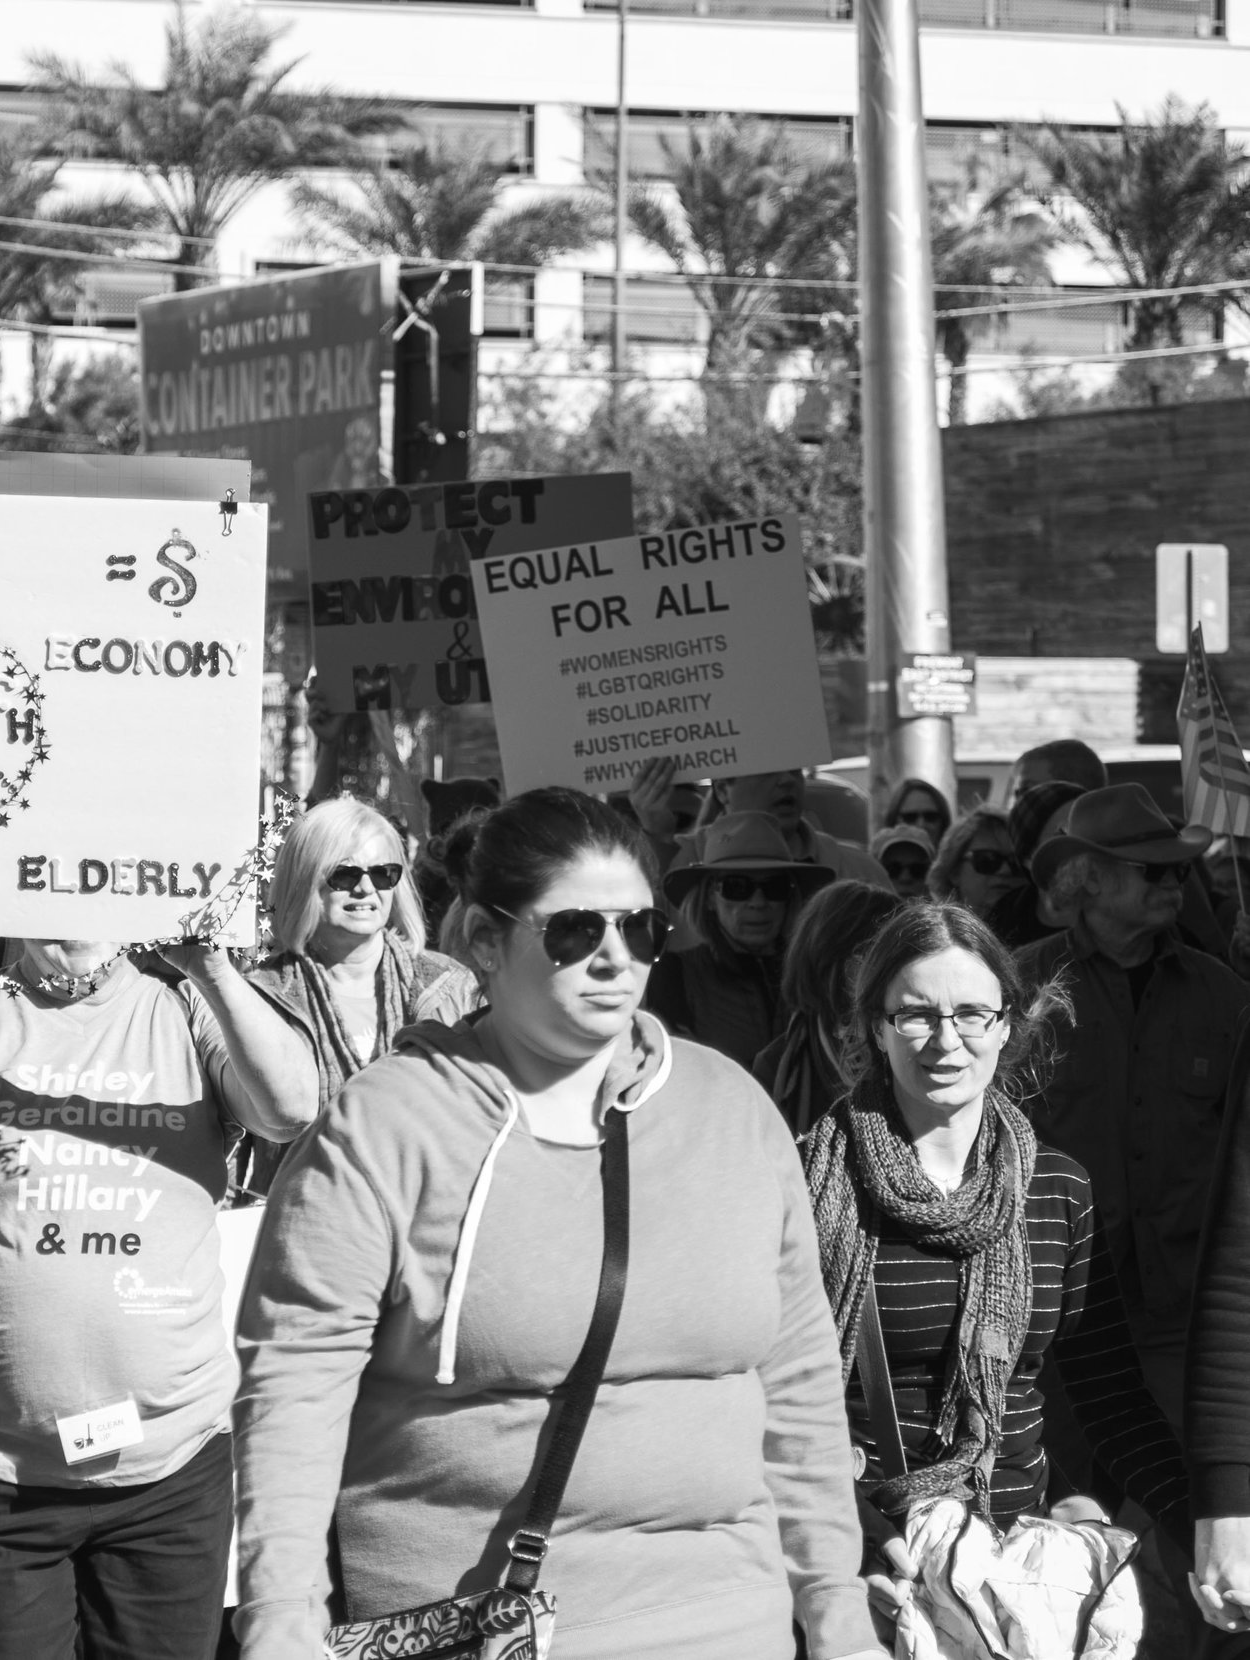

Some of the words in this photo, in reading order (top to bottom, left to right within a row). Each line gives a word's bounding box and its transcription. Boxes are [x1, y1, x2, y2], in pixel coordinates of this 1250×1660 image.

[200, 311, 311, 356] DOWNTOWN
[144, 355, 292, 438] CONTAINER
[299, 339, 377, 417] PARK
[310, 480, 545, 539] PROTECT
[483, 545, 614, 594] EQUAL
[639, 518, 787, 571] RIGHTS
[311, 573, 478, 627] ENVIRO
[551, 595, 632, 638] FOR
[654, 580, 730, 620] ALL
[45, 634, 248, 678] ECONOMY
[446, 620, 473, 661] &
[558, 633, 728, 677] #WOMENSRIGHTS
[352, 662, 420, 711] MY
[575, 661, 725, 700] #LGBTQRIGHTS
[586, 692, 713, 727] #SOLIDARITY
[573, 718, 741, 759] #JUSTICEFORALL
[582, 746, 738, 785] #WHYMARCH
[18, 854, 222, 899] ELDERLY
[16, 1061, 156, 1105] Shirley
[18, 1133, 159, 1177] Nancy
[16, 1172, 163, 1223] Hillary
[35, 1222, 66, 1255] &
[80, 1231, 142, 1256] me
